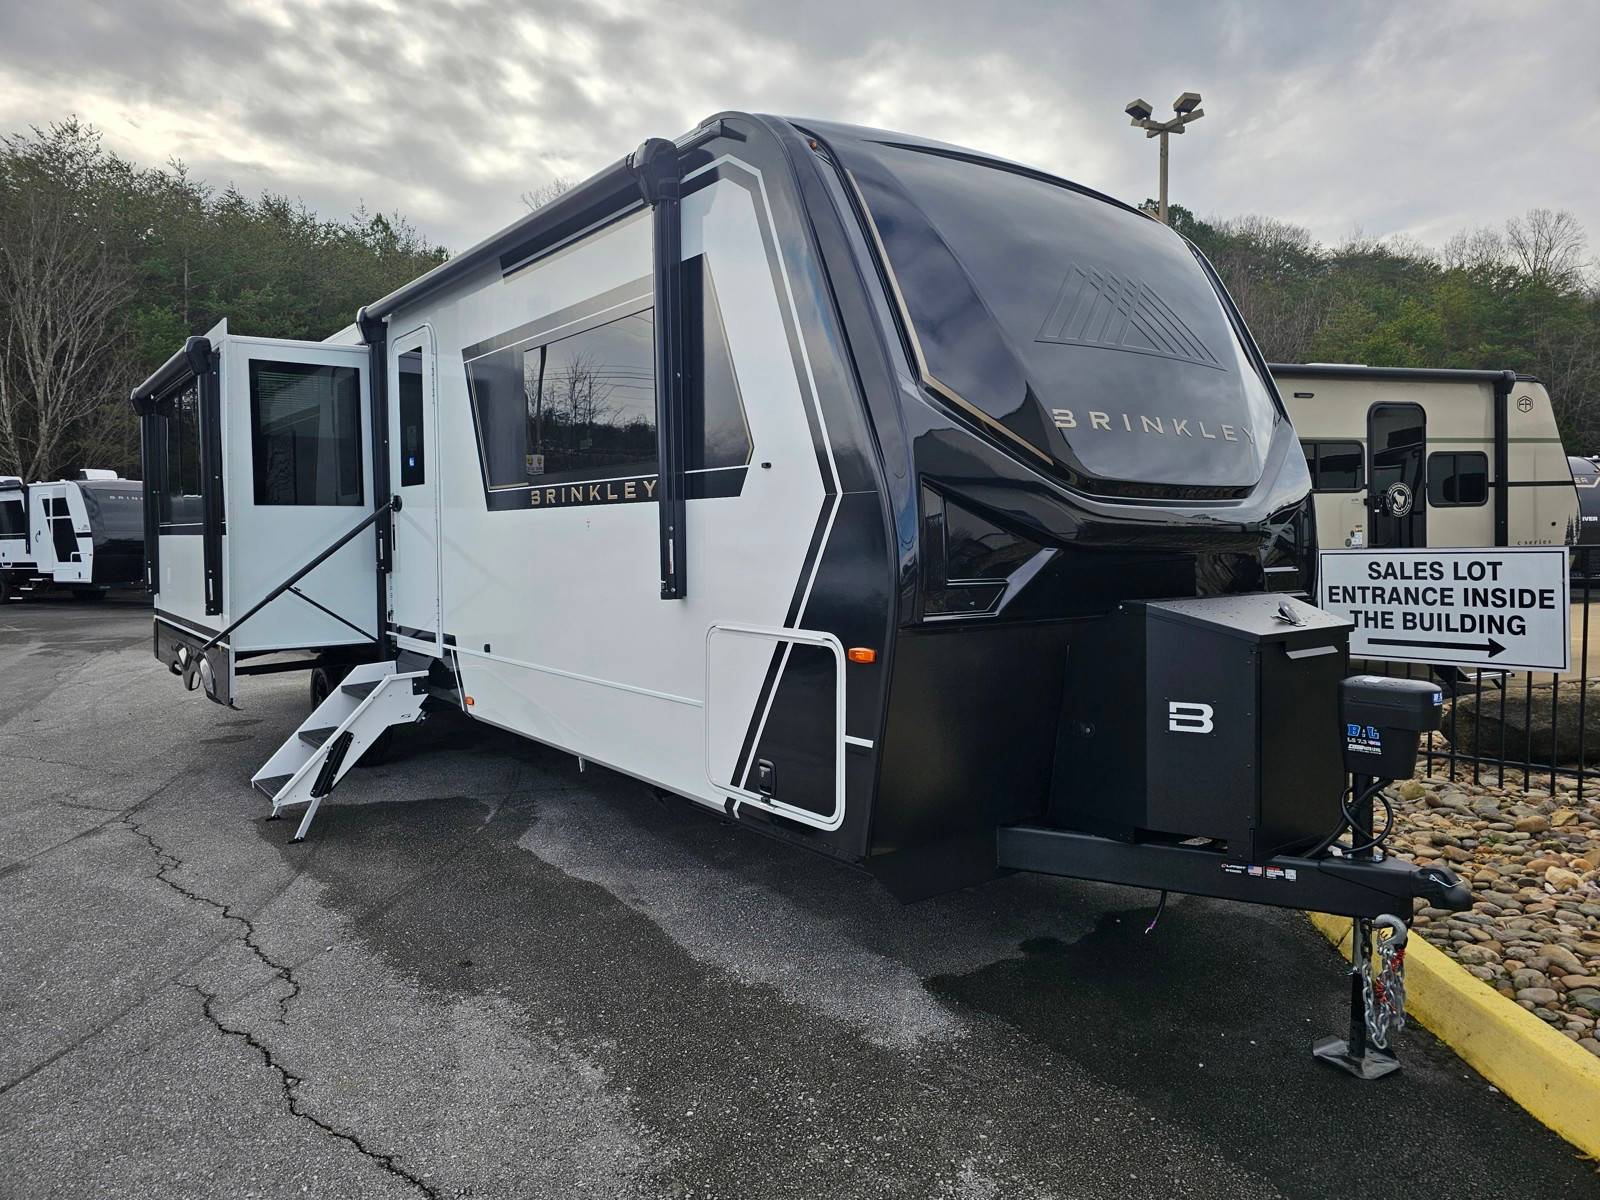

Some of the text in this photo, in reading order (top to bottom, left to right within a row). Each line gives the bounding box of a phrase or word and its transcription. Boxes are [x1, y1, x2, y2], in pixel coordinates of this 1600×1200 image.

[1051, 408, 1256, 444] BRINKLEY
[531, 480, 657, 505] BRINKLEY
[1368, 561, 1503, 581] SALES LOT
[1328, 586, 1556, 610] ENTRANCE INSIDE
[1349, 610, 1526, 636] THE BUILDING
